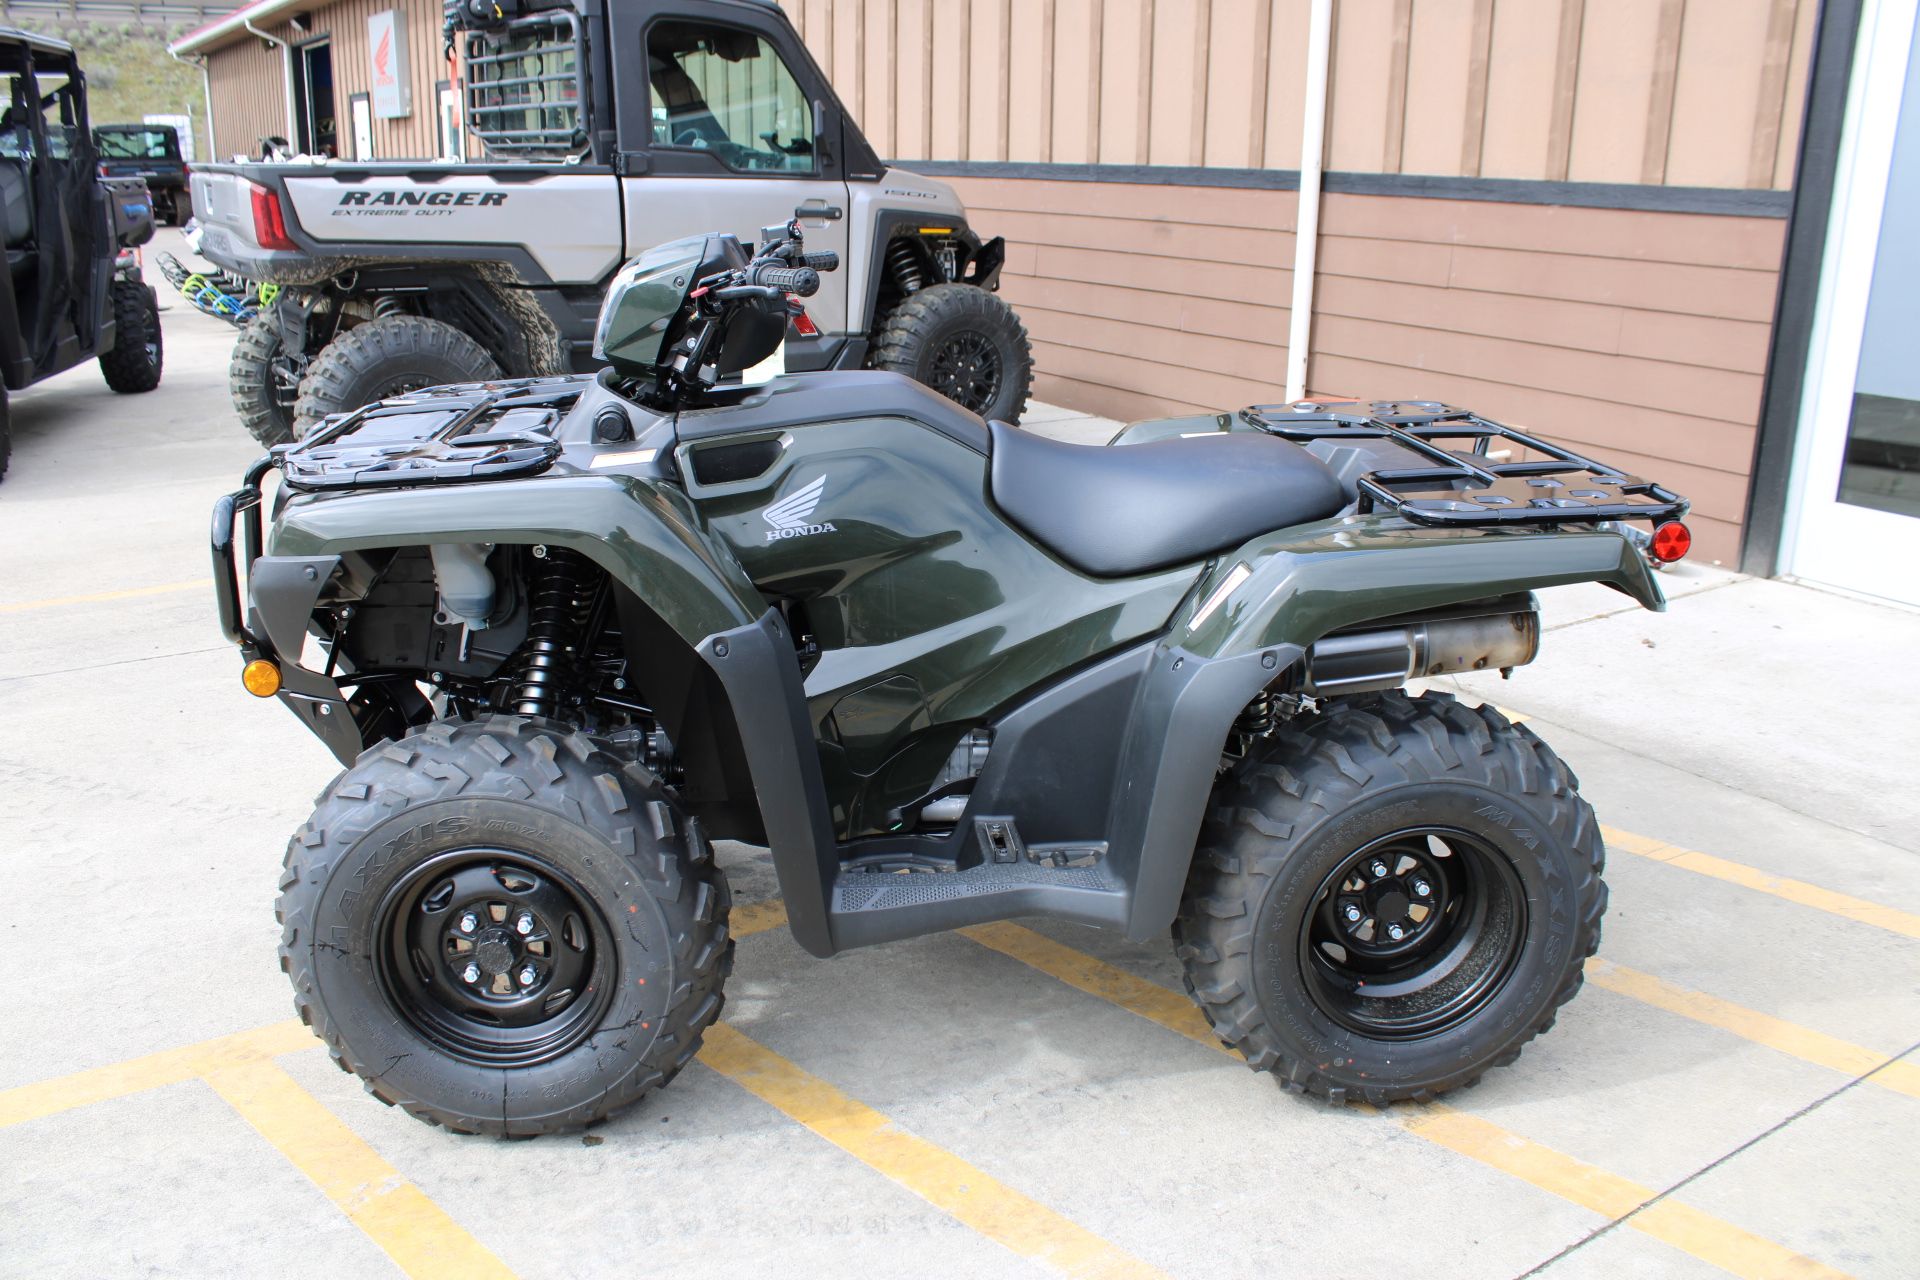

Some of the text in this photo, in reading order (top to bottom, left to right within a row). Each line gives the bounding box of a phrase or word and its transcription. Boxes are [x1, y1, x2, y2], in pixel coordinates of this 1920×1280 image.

[338, 191, 508, 206] RANGER
[884, 189, 937, 199] 1500
[765, 522, 838, 541] HONDA
[330, 815, 473, 956] MAXXIS
[1472, 804, 1567, 966] MAXXIS
